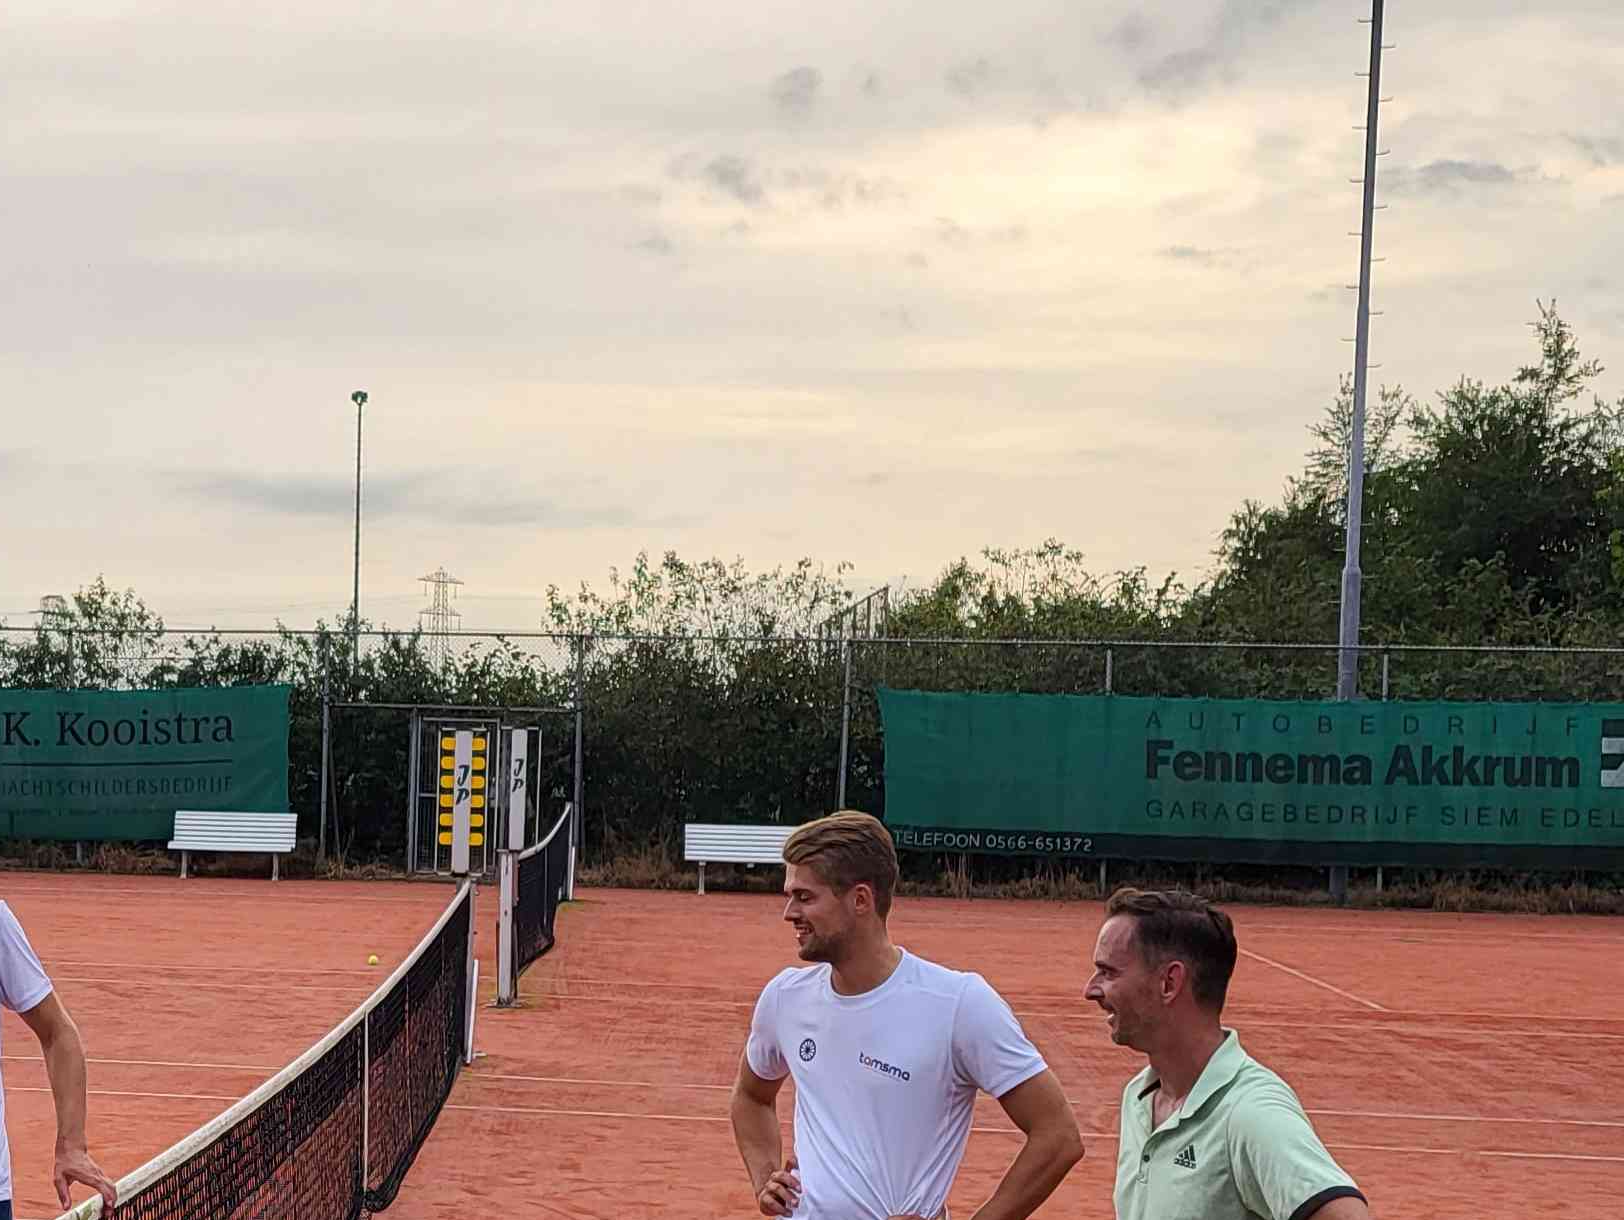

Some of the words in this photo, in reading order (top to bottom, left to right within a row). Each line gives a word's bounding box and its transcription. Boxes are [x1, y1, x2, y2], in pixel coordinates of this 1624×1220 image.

[0, 711, 41, 747] K.
[55, 708, 235, 746] Kooistra
[1145, 740, 1372, 786] Fennema
[1383, 743, 1581, 788] Akkrum
[1145, 800, 1420, 827] GARAGEBEDRIJF
[1439, 806, 1519, 828] SIEM
[893, 829, 981, 848] TELEFOON
[985, 833, 1093, 853] 0566-651372
[859, 1051, 911, 1082] tamsma
